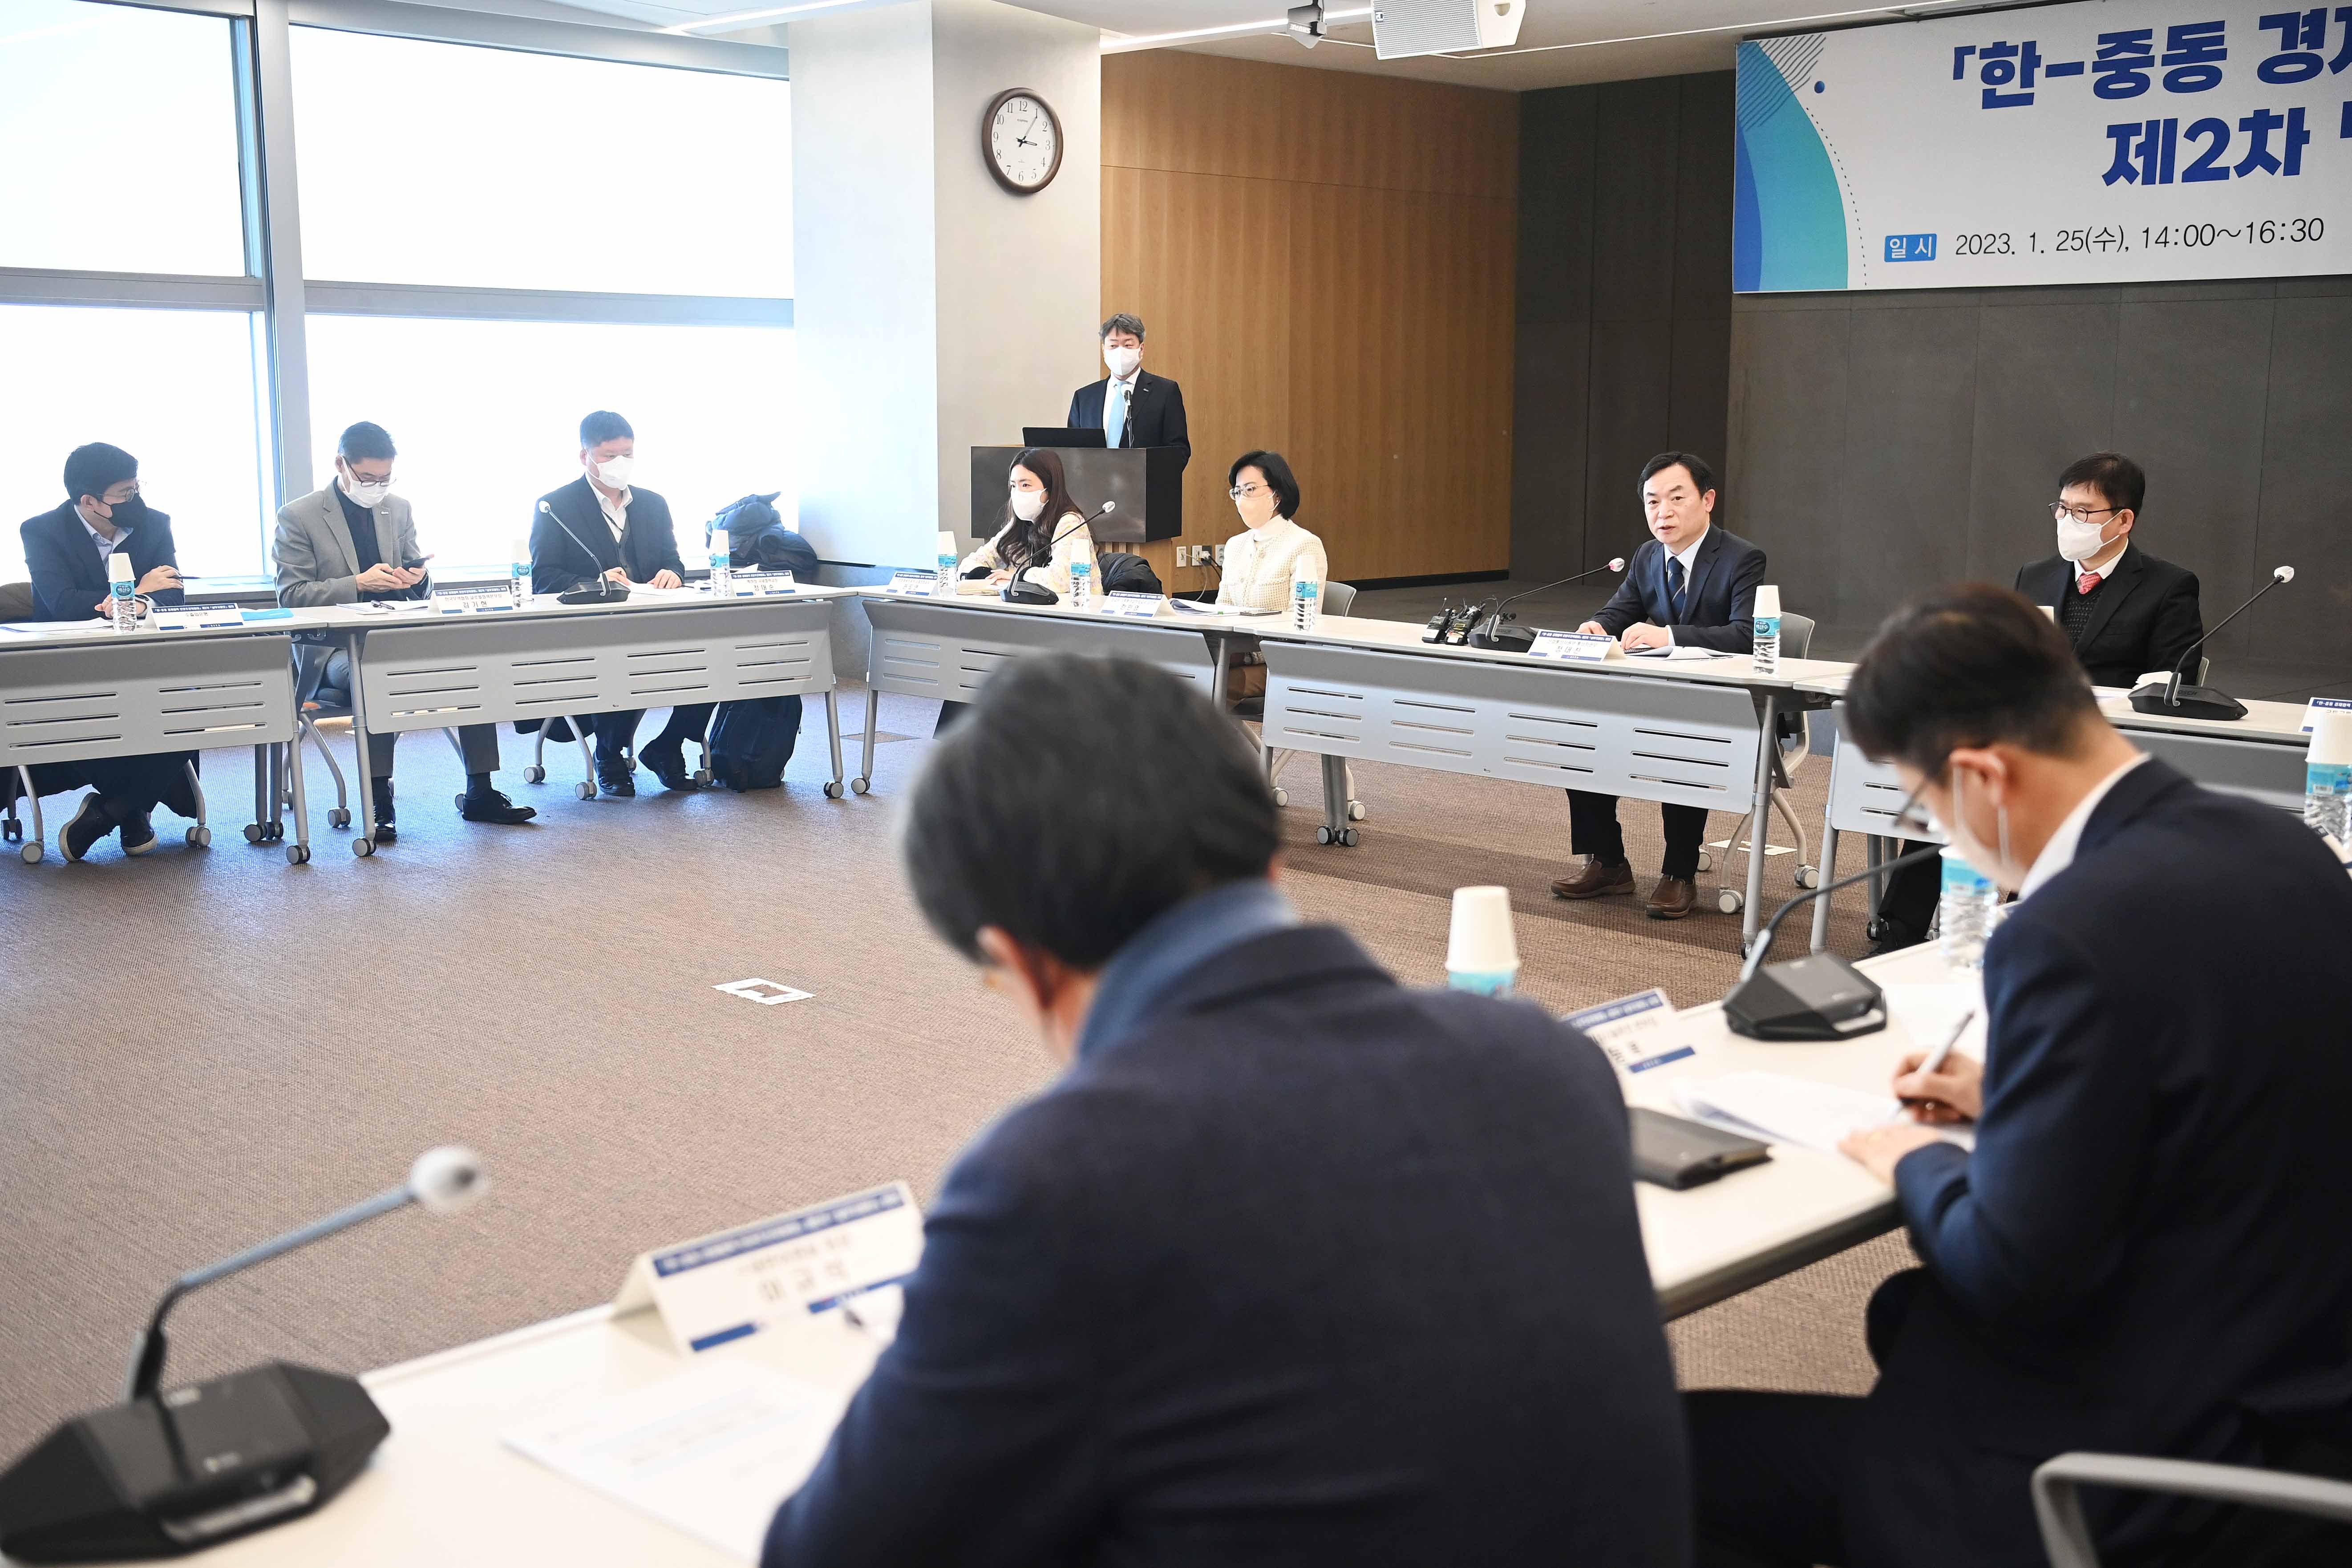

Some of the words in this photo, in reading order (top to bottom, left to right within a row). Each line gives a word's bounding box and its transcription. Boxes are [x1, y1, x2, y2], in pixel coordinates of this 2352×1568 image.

[1007, 102, 1013, 113] 11
[1019, 101, 1028, 112] 12
[996, 114, 1004, 125] 10
[1042, 121, 1047, 132] 2
[993, 132, 999, 143] 9
[1045, 140, 1051, 150] 3
[2102, 107, 2311, 186] 제2차
[996, 149, 1002, 160] 8
[1041, 157, 1047, 167] 4
[1006, 165, 1012, 175] 7
[1031, 169, 1037, 179] 5
[1018, 171, 1024, 182] 6
[1955, 233, 2016, 255] 2023.
[2029, 231, 2045, 254] 1.
[2056, 226, 2129, 254] 25(수),
